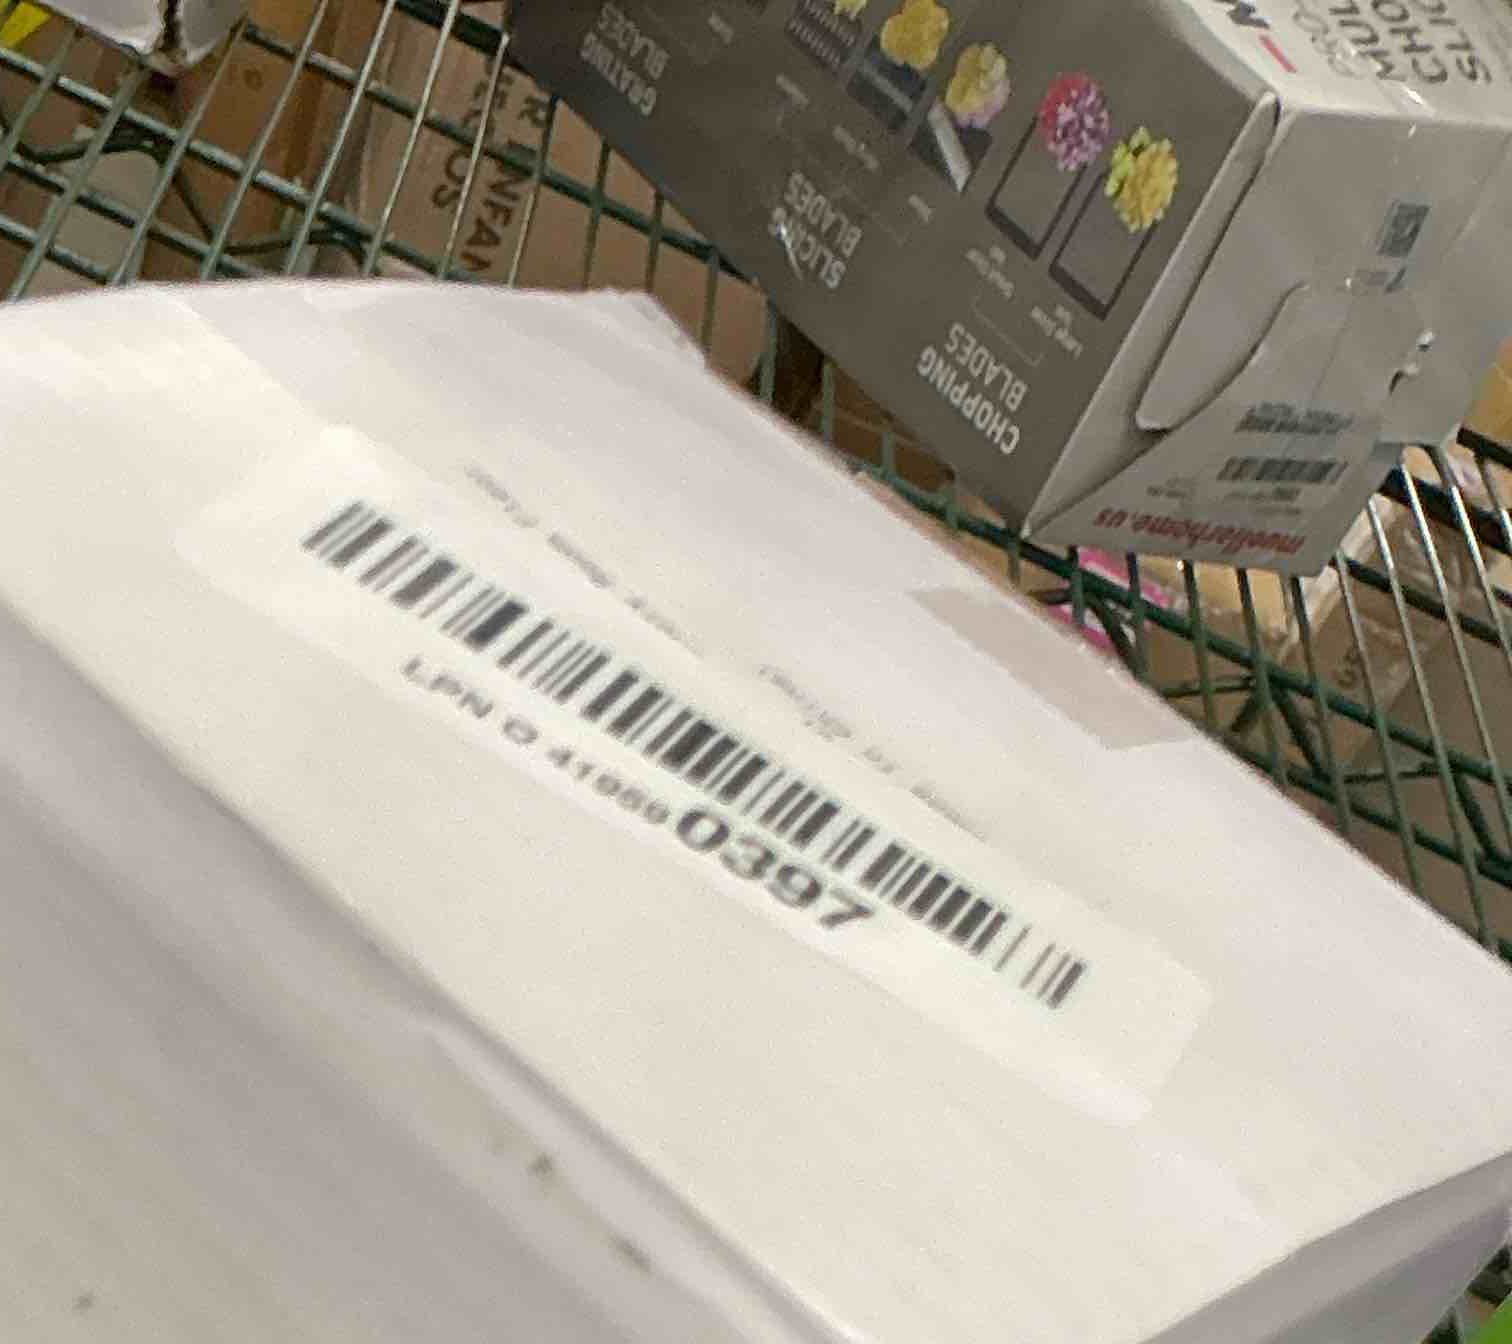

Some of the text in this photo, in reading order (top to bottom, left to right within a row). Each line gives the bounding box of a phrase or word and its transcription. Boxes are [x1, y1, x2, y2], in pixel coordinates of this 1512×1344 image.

[784, 171, 862, 258] BLADES
[917, 347, 1020, 454] CHOPPING
[945, 323, 1028, 411] BLADES
